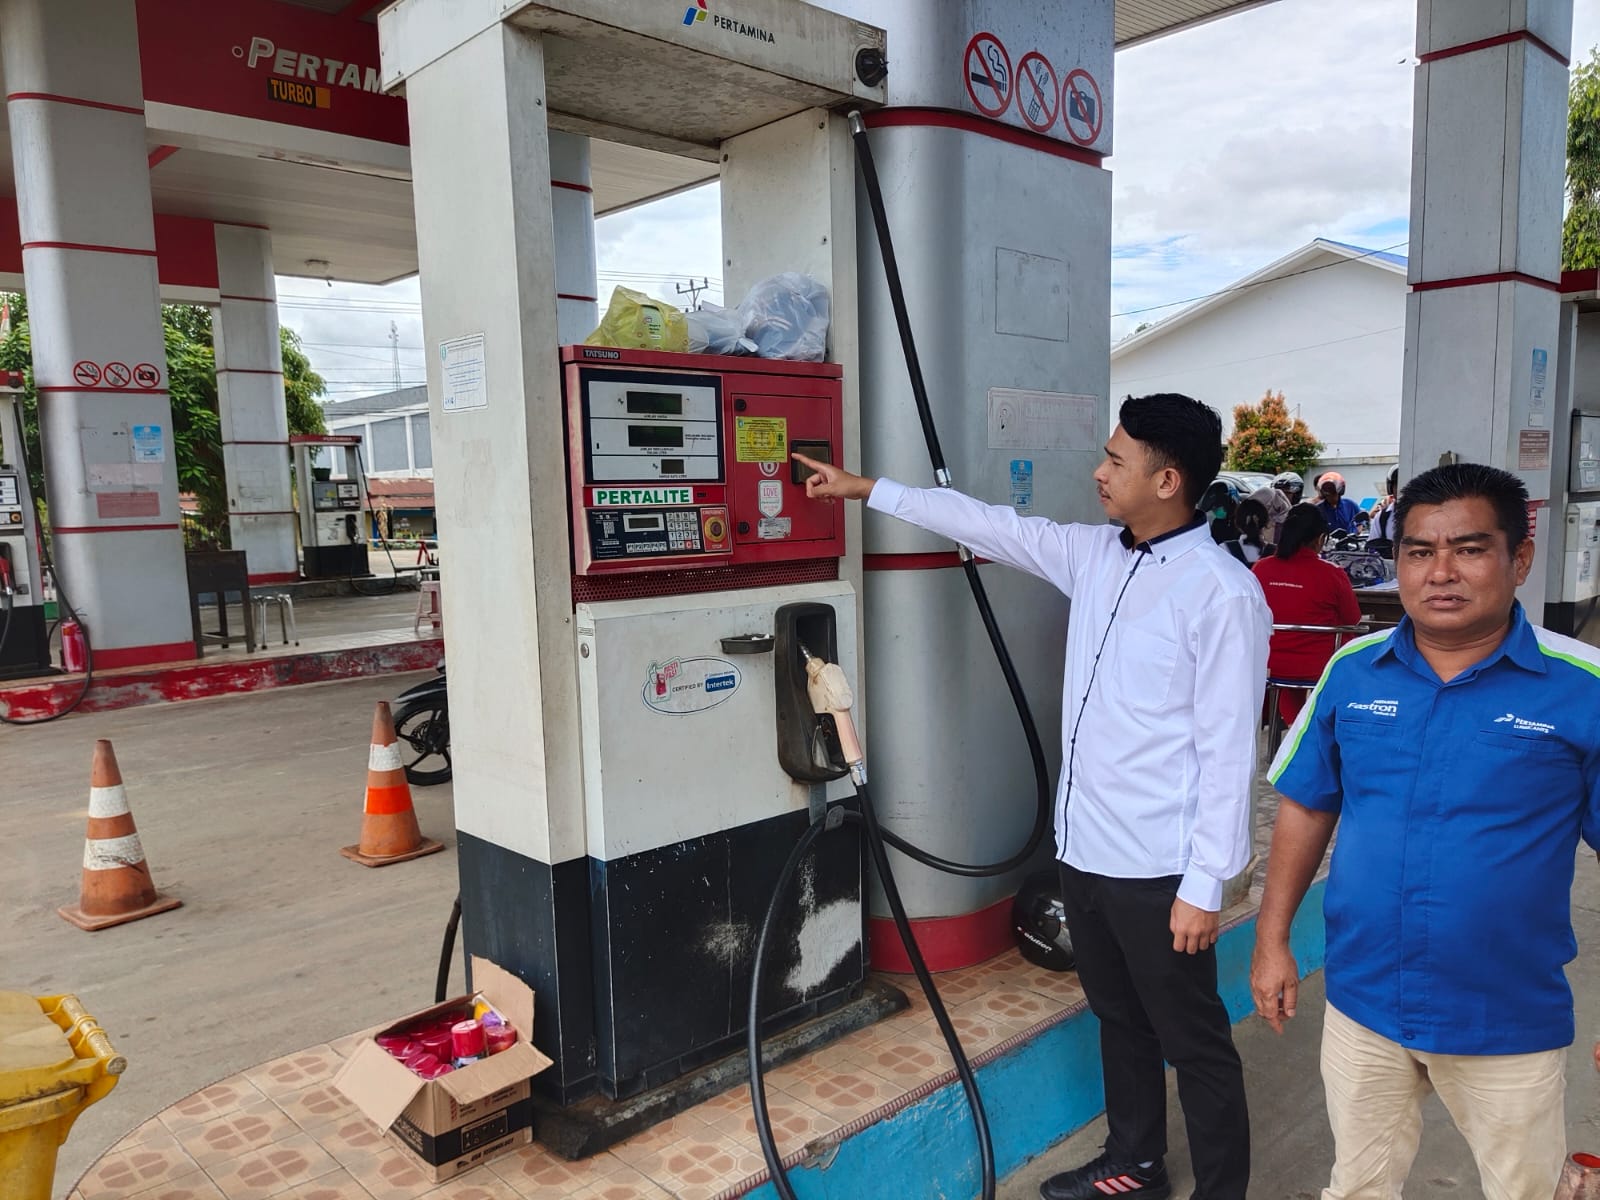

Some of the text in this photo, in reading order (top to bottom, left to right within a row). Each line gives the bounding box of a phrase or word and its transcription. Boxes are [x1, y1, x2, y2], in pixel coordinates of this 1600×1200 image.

[714, 15, 775, 44] PERTAMINA
[247, 36, 396, 97] PERTAM
[271, 79, 313, 105] TURBO
[584, 350, 619, 359] TATSUNO
[597, 490, 690, 504] PERTALITE
[706, 678, 735, 690] Intertek
[1347, 702, 1397, 713] Fastron
[1515, 717, 1555, 730] PERTAMINA
